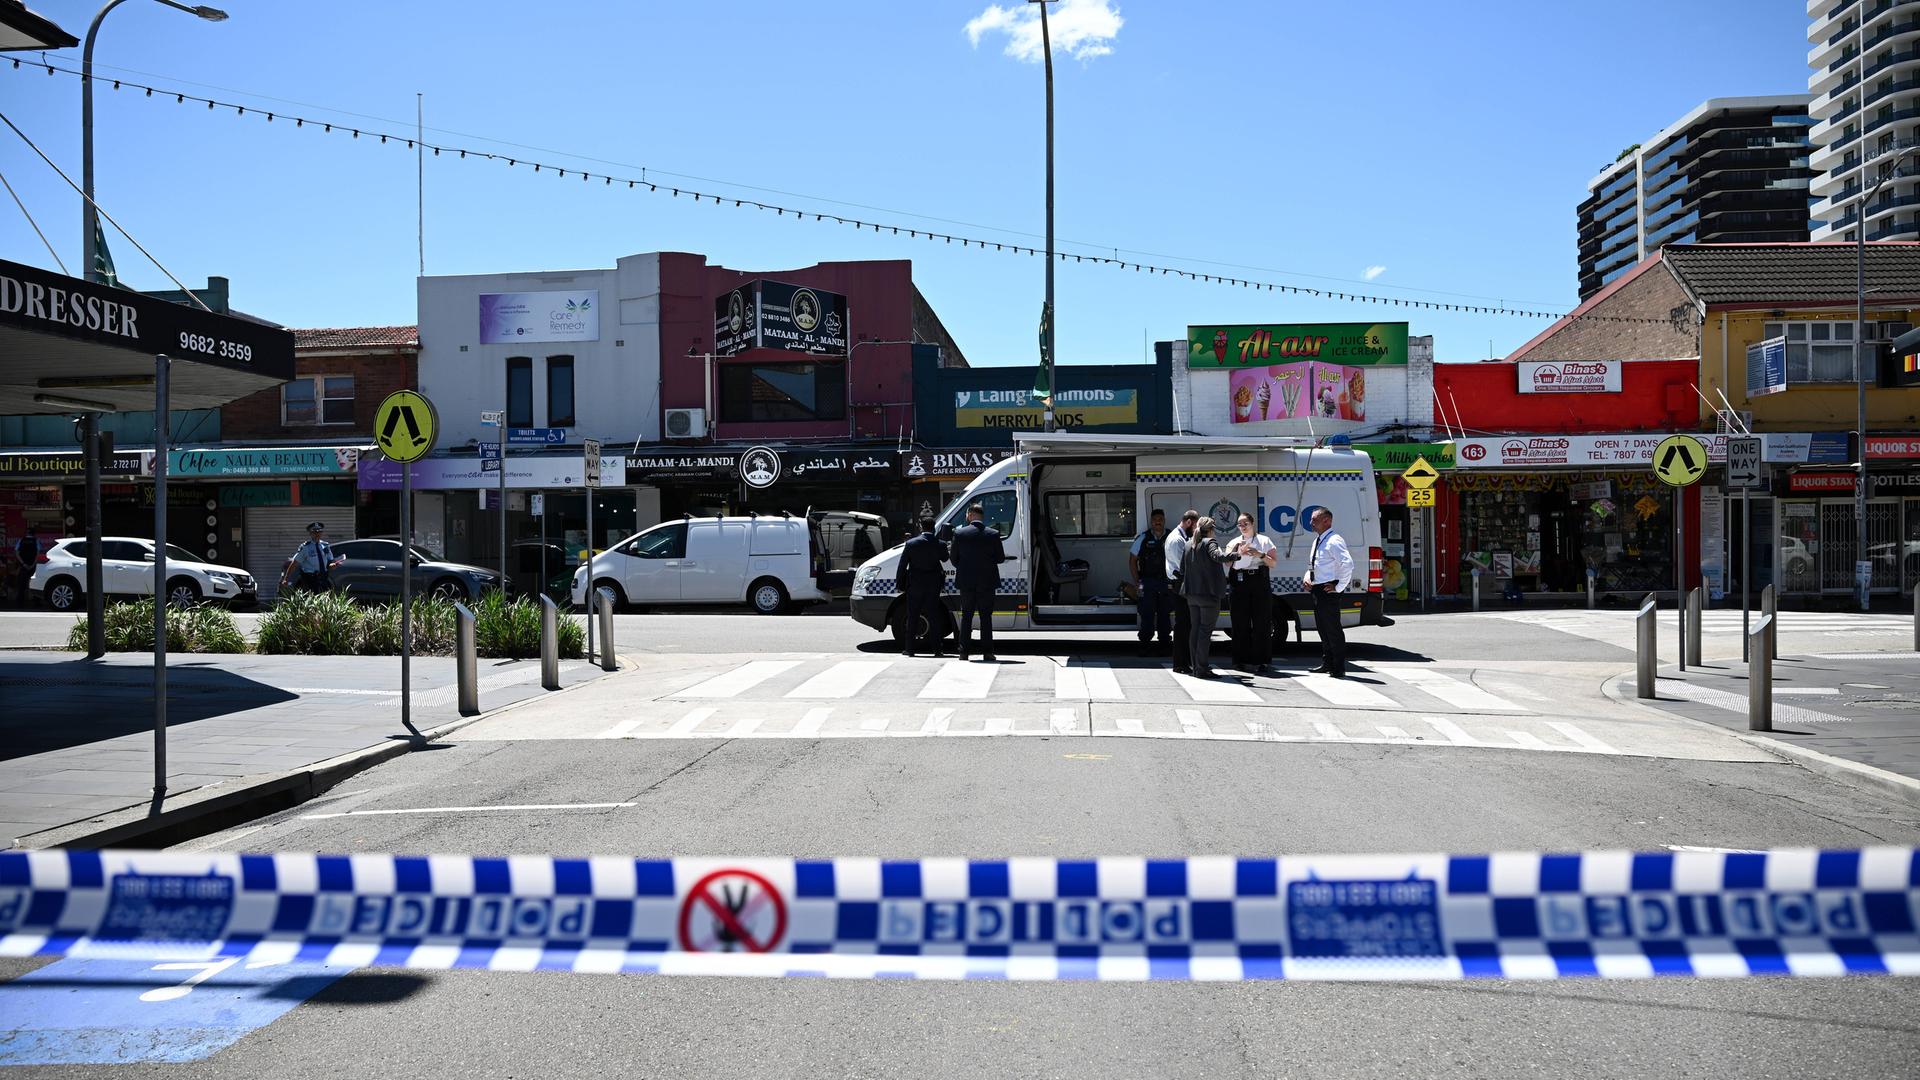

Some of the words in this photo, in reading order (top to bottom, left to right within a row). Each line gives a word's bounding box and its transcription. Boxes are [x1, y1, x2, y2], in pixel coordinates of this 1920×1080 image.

[0, 275, 140, 339] DRESSER
[550, 311, 573, 320] Care
[764, 328, 799, 340] MATAAM
[805, 334, 815, 342] AL
[820, 336, 845, 347] MANDI
[180, 331, 216, 355] 9682
[219, 339, 252, 362] 3559
[1237, 329, 1329, 364] Al-asr
[1339, 336, 1369, 345] JUICE
[1371, 336, 1380, 345] &
[1331, 347, 1348, 357] ICE
[1351, 346, 1389, 356] CREAM
[1563, 363, 1606, 375] Binas's
[983, 413, 1084, 428] MERRYLNDS
[586, 443, 598, 455] ONE
[1464, 447, 1484, 458] 163
[1528, 438, 1569, 449] Binas's
[1594, 440, 1620, 449] OPEN
[1623, 440, 1629, 448] 7
[1633, 439, 1659, 448] DAYS
[1732, 443, 1756, 455] ONE
[1864, 442, 1907, 455] LIQUOR
[932, 452, 994, 468] BINAS
[1587, 451, 1609, 460] TEL:
[1613, 450, 1636, 459] 7807
[179, 451, 218, 473] Chloe
[225, 454, 257, 466] NAIL
[259, 454, 270, 466] &
[274, 452, 327, 466] BEAUTY
[485, 460, 500, 471] LIBRARY
[586, 459, 599, 470] WAY
[626, 456, 735, 468] MATAAM-AL-MANDI
[792, 457, 846, 474] الماندي
[852, 456, 890, 473] مطعم
[1731, 458, 1757, 470] WAY
[1792, 478, 1829, 487] LIQUOR
[1830, 477, 1853, 486] STAX
[1411, 490, 1431, 501] 25
[928, 901, 1183, 942] POLICE
